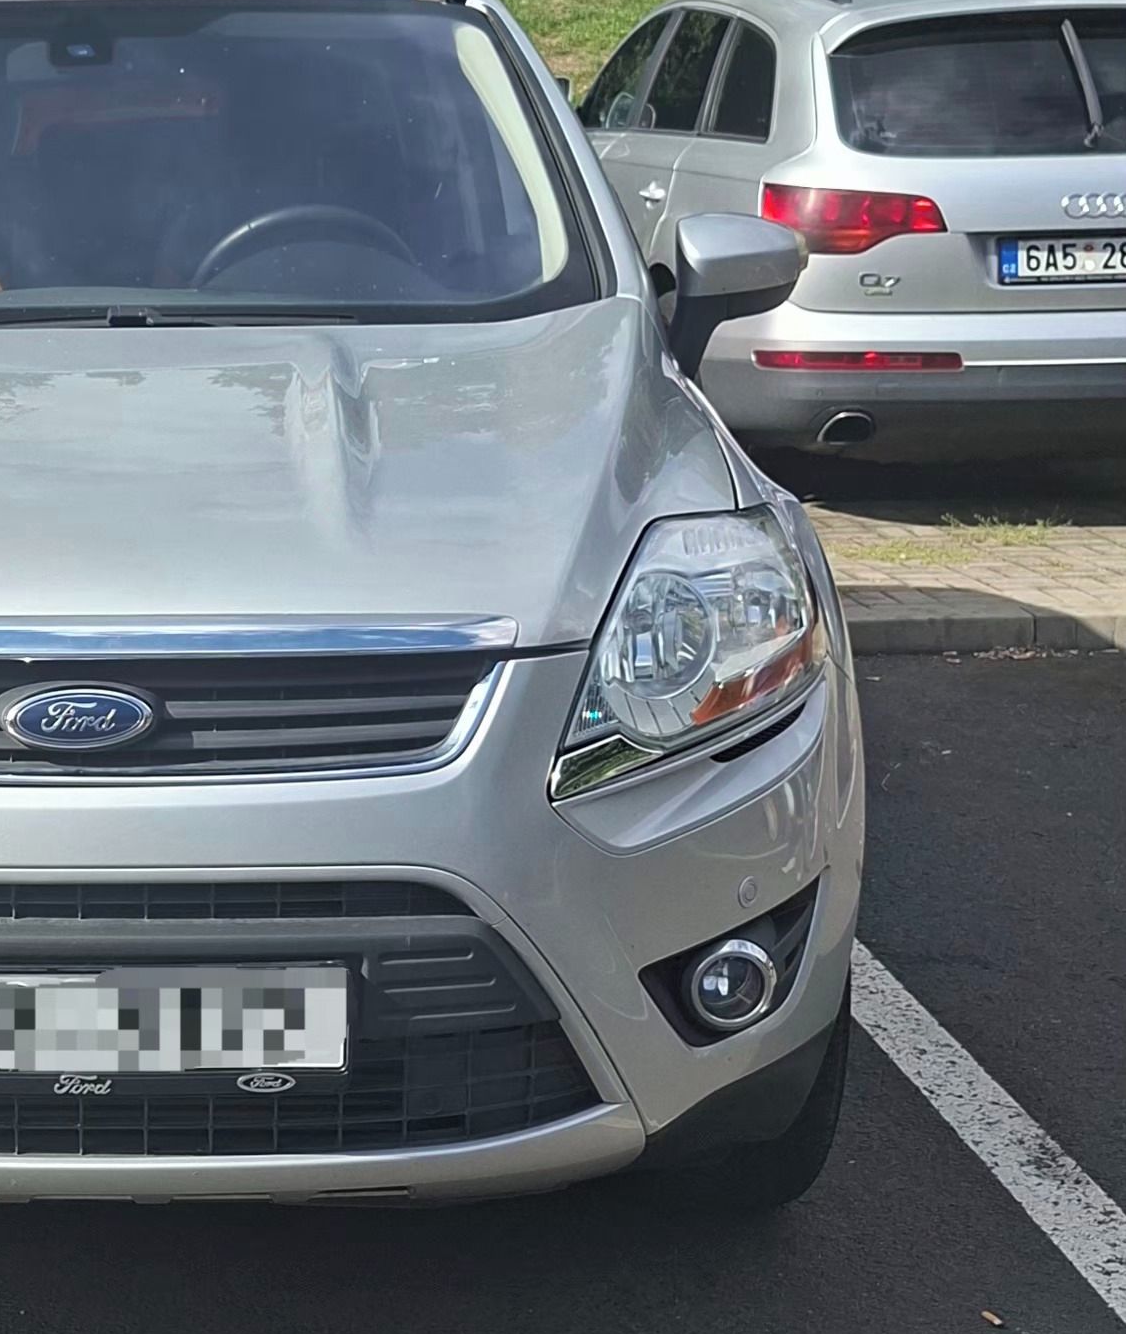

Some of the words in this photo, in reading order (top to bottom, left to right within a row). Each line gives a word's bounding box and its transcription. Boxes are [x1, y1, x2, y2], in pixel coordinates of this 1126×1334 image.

[1025, 243, 1078, 272] 6A5
[859, 273, 901, 288] Q7
[40, 701, 117, 733] Ford
[53, 1074, 113, 1095] Ford
[250, 1076, 283, 1088] Ford
